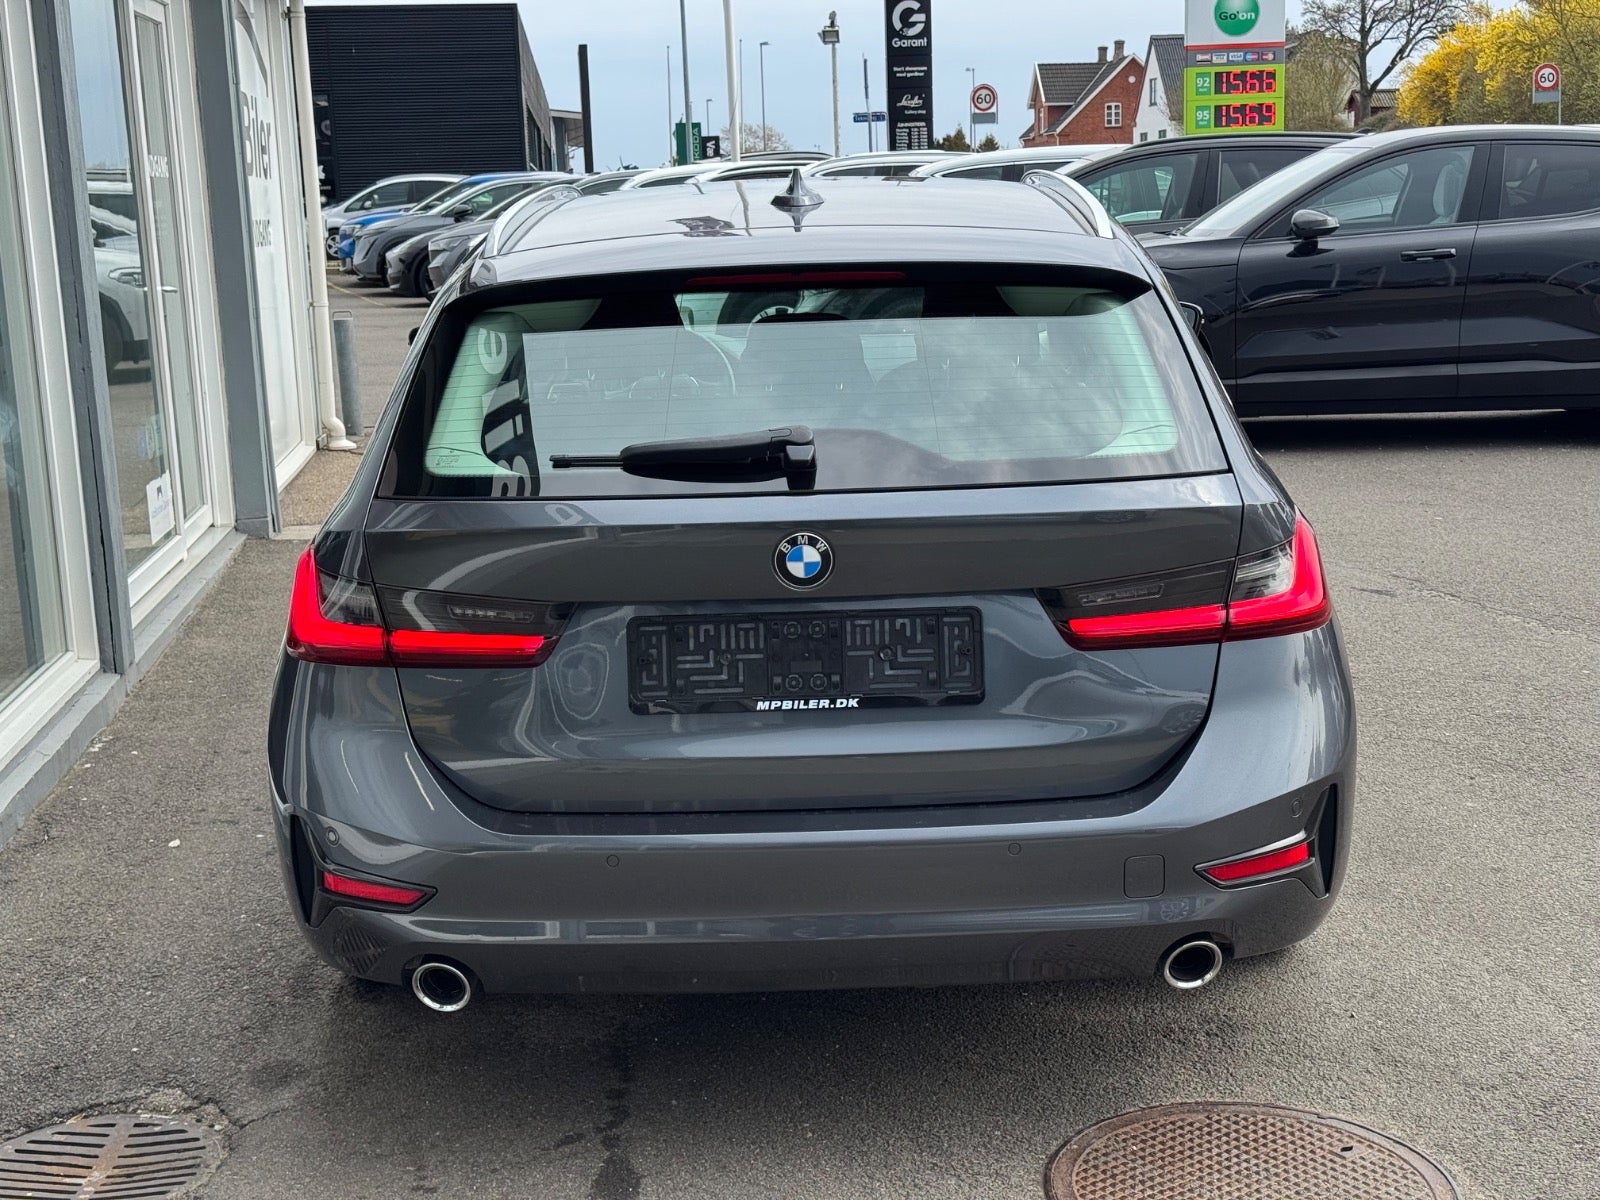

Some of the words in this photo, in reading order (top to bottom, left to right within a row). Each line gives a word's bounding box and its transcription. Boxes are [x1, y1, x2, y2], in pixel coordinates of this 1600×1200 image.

[1219, 10, 1256, 21] Go'on
[892, 36, 928, 48] Garant
[1196, 77, 1210, 88] 92
[1539, 72, 1555, 84] 60
[976, 93, 992, 105] 60
[1196, 110, 1210, 121] 95
[239, 90, 272, 180] Biler
[780, 535, 827, 553] BMW
[756, 699, 860, 711] MPBILER.DK
